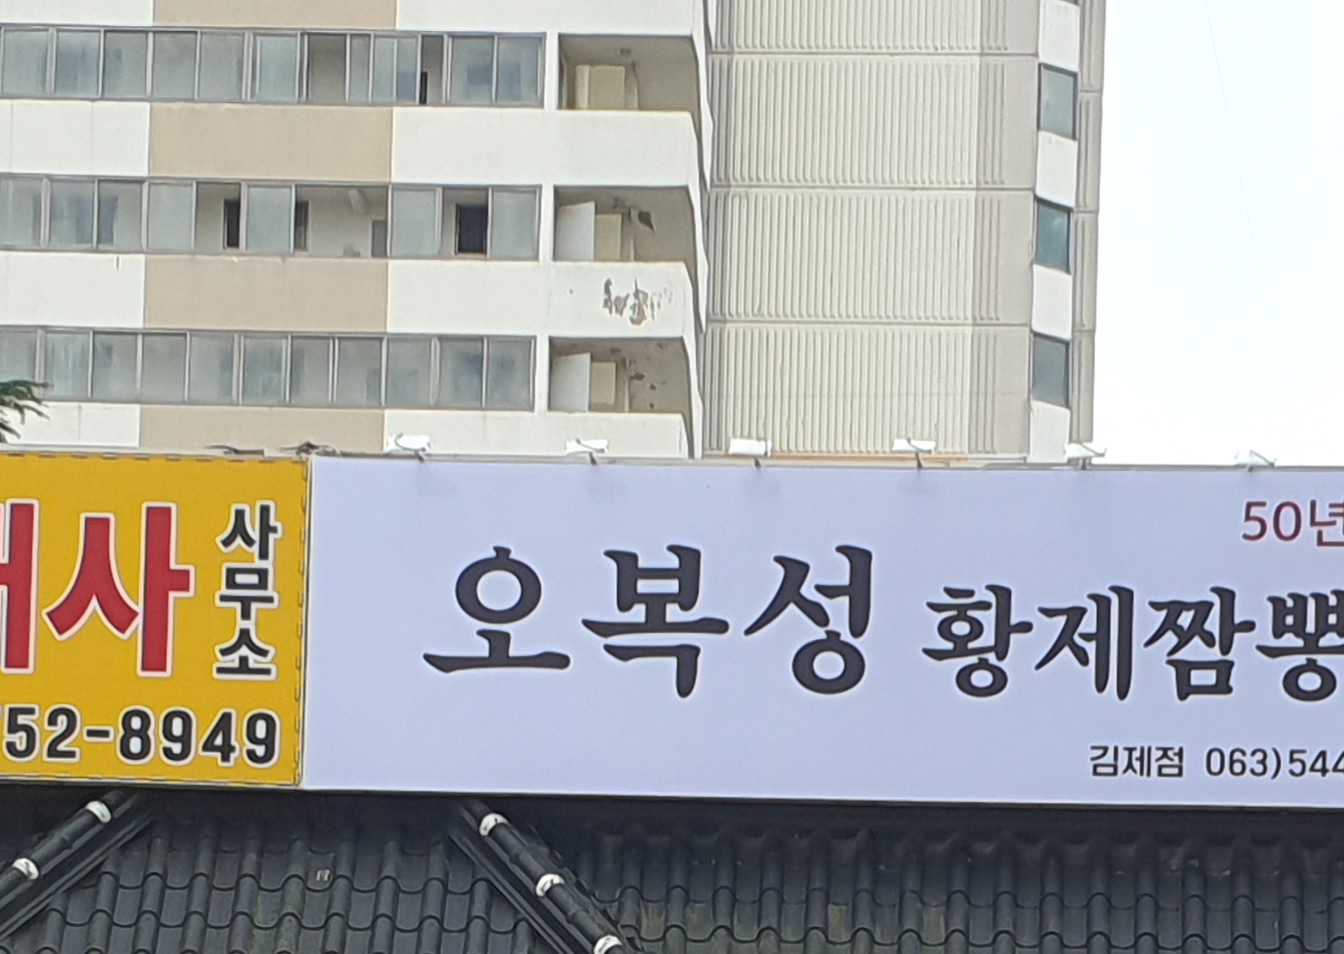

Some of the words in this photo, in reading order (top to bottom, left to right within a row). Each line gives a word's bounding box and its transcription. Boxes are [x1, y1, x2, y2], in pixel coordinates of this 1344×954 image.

[214, 502, 281, 679] 사무소
[422, 544, 875, 700] 오복성
[1088, 745, 1185, 781] 김제점
